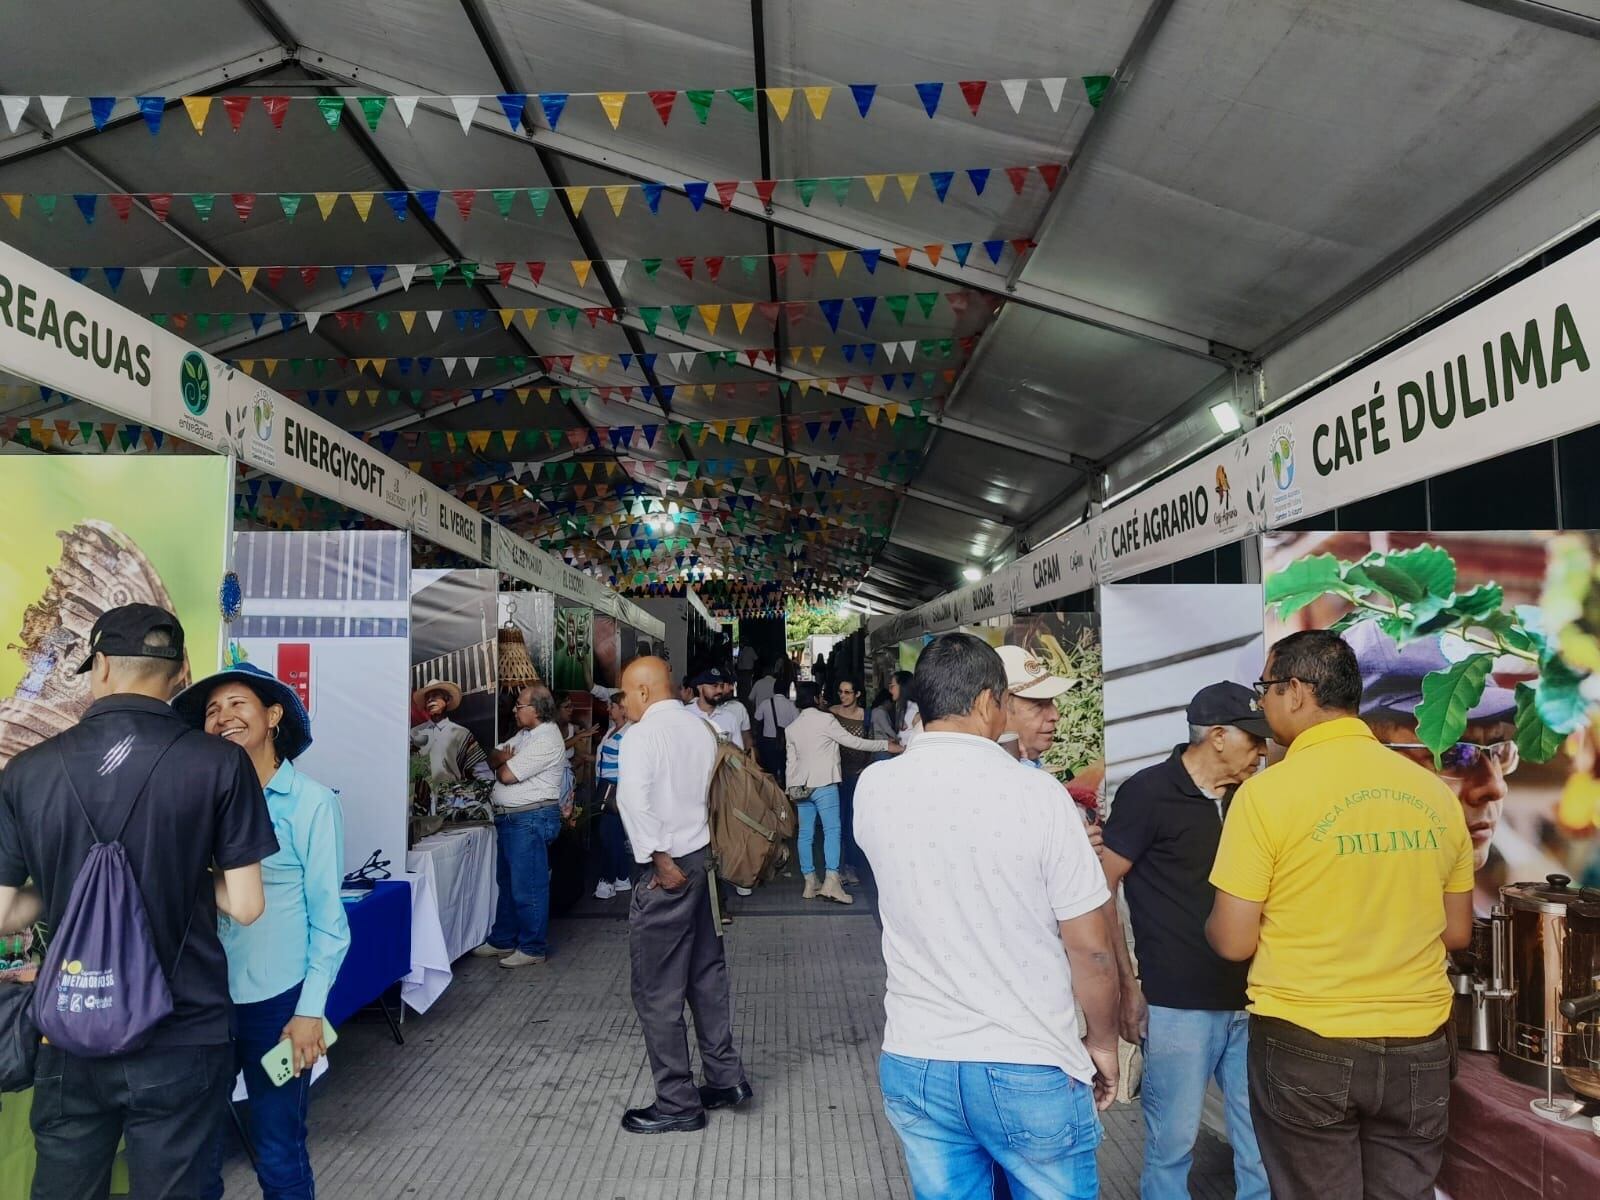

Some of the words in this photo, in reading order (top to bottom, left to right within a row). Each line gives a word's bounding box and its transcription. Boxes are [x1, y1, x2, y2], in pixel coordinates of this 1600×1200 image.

[1312, 381, 1390, 476] CAFÉ
[1397, 303, 1591, 443] DULIMA
[284, 416, 385, 499] ENERGYSOFT
[439, 503, 449, 530] EL
[1111, 509, 1141, 558] CAFÉ
[1143, 485, 1209, 548] AGRARIO
[1032, 552, 1061, 589] CAFAM
[1311, 805, 1345, 843] FINCA
[1335, 828, 1440, 856] DULIMA
